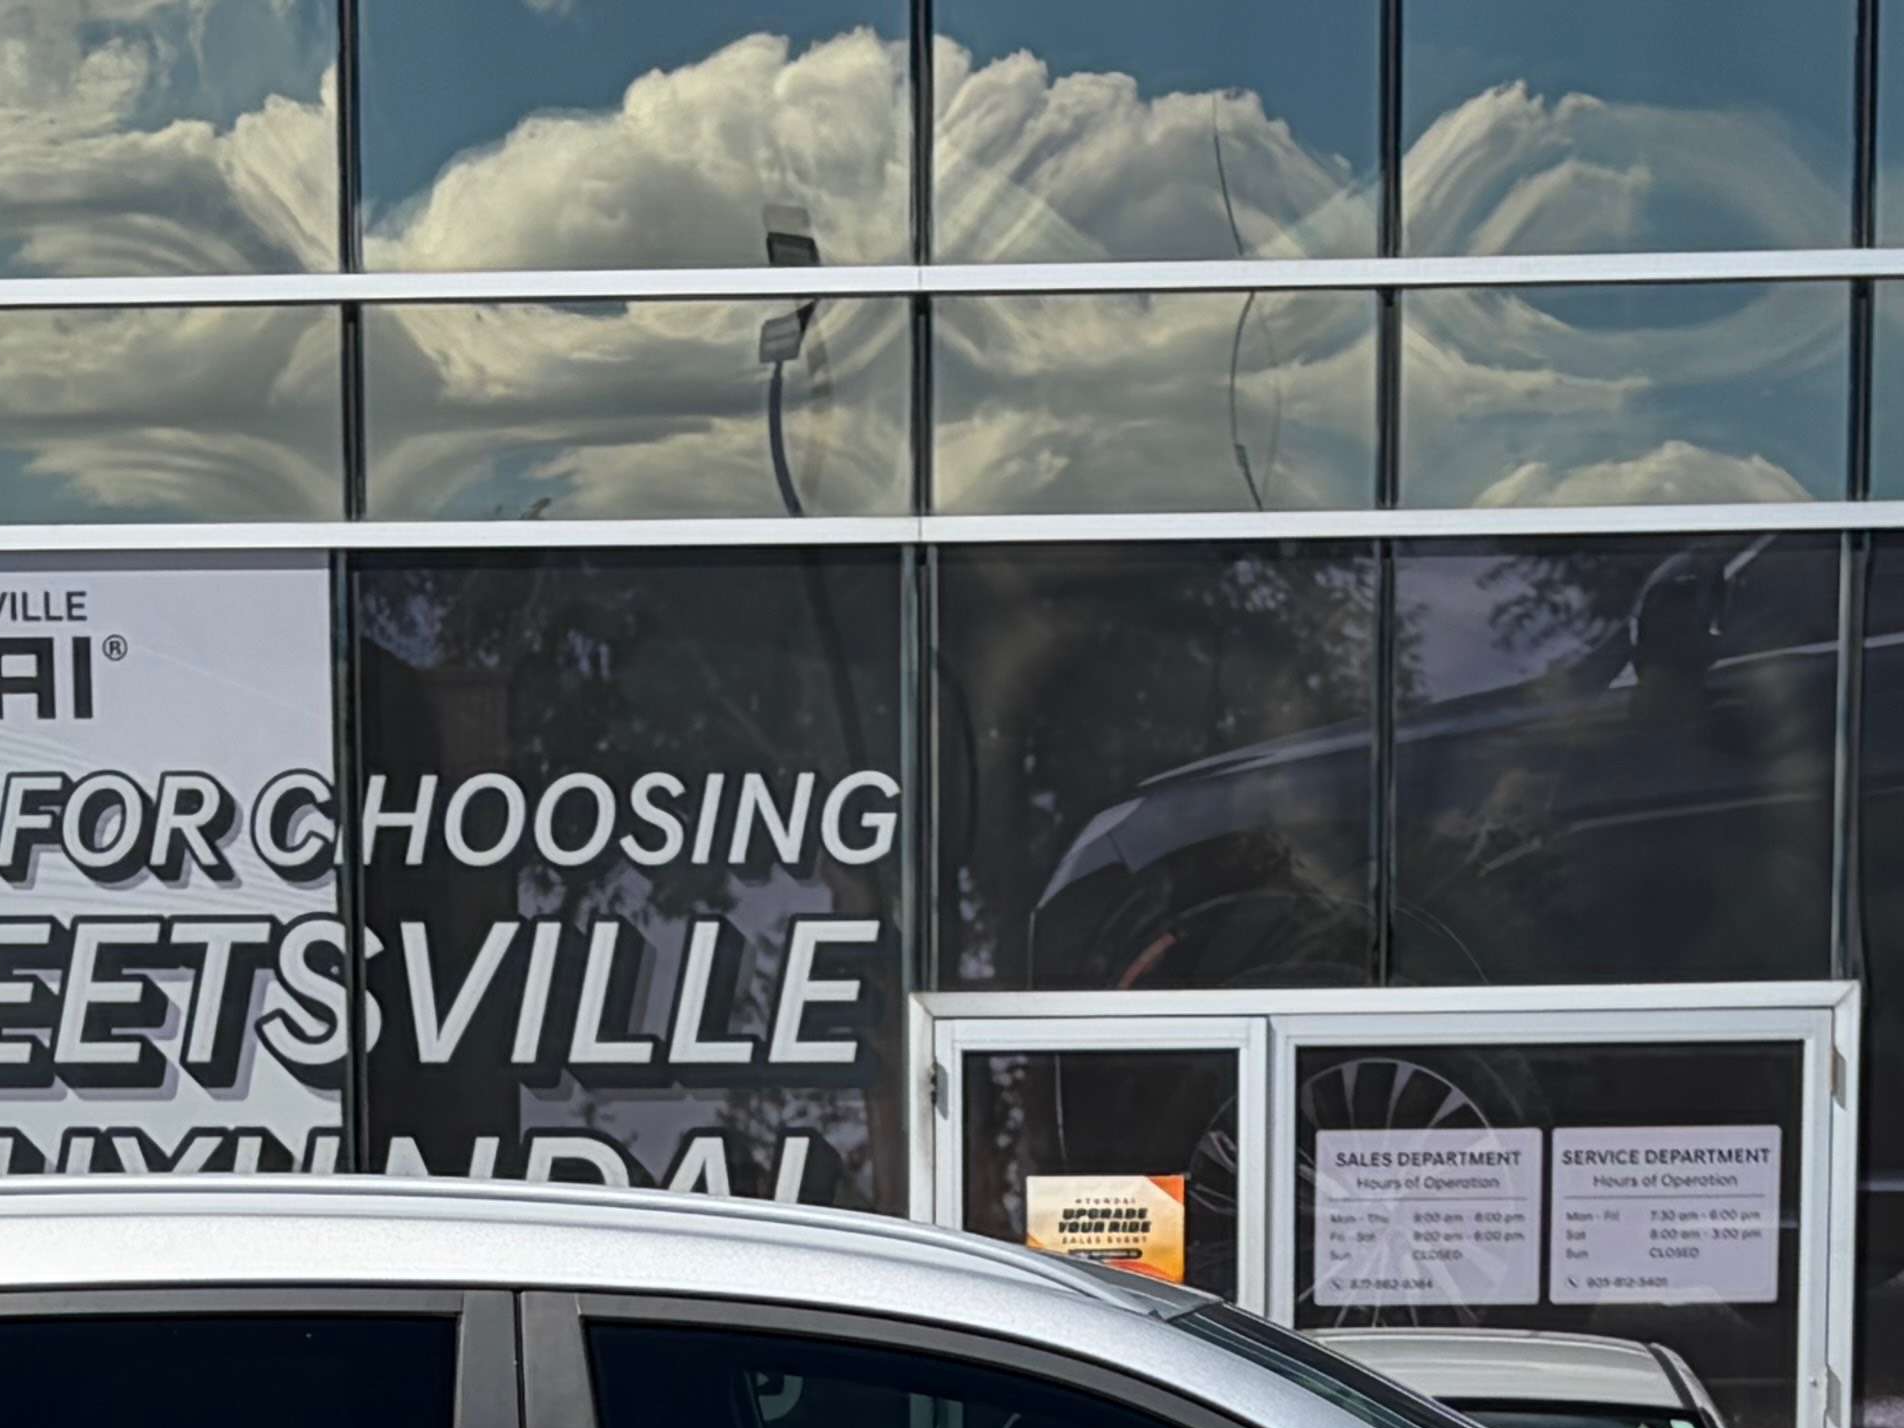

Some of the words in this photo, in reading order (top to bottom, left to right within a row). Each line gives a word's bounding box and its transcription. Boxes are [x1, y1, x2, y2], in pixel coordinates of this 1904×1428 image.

[250, 768, 901, 880] CHOOSING
[1336, 1152, 1393, 1167] SALES
[1397, 1151, 1521, 1167] DEPARTMENT
[1561, 1149, 1639, 1165] SERVICE
[1644, 1148, 1770, 1164] DEPARTMENT
[1356, 1177, 1402, 1190] Hours
[1404, 1176, 1420, 1189] of
[1423, 1176, 1500, 1191] Operation
[1593, 1175, 1638, 1188] Hours
[1642, 1174, 1658, 1187] of
[1660, 1173, 1737, 1189] Operation
[1062, 1208, 1149, 1219] UPGRADE
[1443, 1215, 1463, 1223] am
[1504, 1214, 1526, 1224] pm
[1566, 1211, 1594, 1221] Mon
[1603, 1210, 1620, 1221] Fri
[1678, 1212, 1699, 1222] am
[1740, 1212, 1761, 1223] pm
[1058, 1221, 1105, 1233] YOUR
[1108, 1221, 1152, 1233] RIDE
[1443, 1233, 1463, 1242] am
[1504, 1232, 1525, 1243] pm
[1566, 1230, 1586, 1240] Sat
[1680, 1231, 1700, 1240] am
[1741, 1231, 1762, 1242] pm
[1412, 1250, 1463, 1261] CLOSED
[1649, 1248, 1700, 1259] CLOSED
